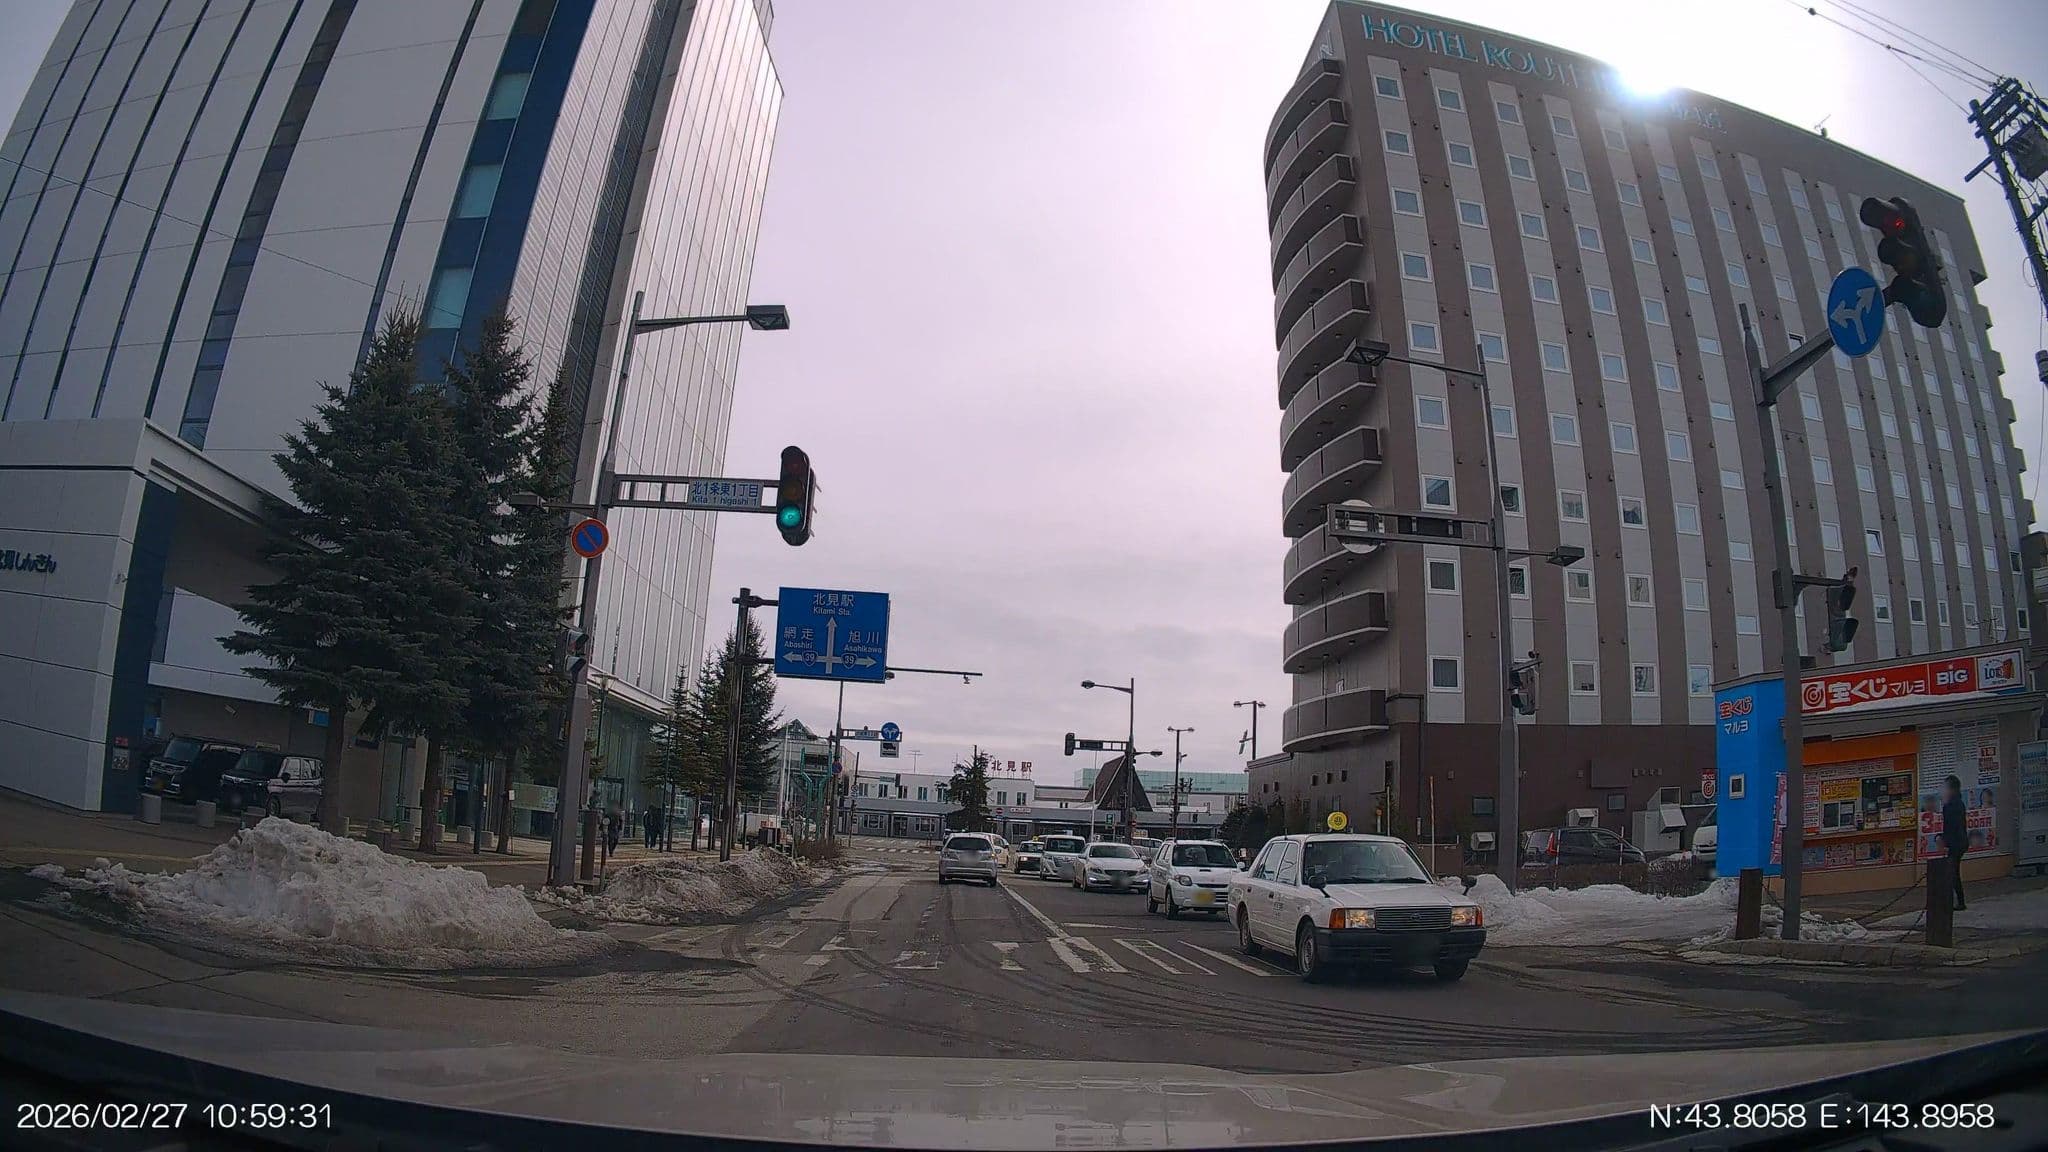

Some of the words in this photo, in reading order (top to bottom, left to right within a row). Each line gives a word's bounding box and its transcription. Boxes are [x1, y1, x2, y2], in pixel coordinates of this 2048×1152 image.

[1361, 14, 1478, 63] HOTEL
[692, 480, 759, 498] 北1条東1丁目
[693, 495, 708, 504] Kita
[720, 497, 749, 506] higashi
[813, 592, 856, 607] 北見駅
[813, 606, 836, 616] Kitami
[838, 608, 852, 616] Sta.
[784, 626, 814, 641] 網走
[848, 630, 880, 645] 旭川
[784, 641, 813, 650] Abashiri
[844, 644, 882, 654] Asahikawa
[805, 653, 815, 662] 39
[844, 656, 854, 664] 39
[1936, 666, 1968, 686] BIG
[1828, 677, 1887, 704] 宝くじ
[1890, 680, 1926, 696] マルヨ
[1719, 697, 1752, 719] 宝くじ
[1724, 720, 1749, 735] マルヨ
[991, 759, 1033, 773] 北見駅
